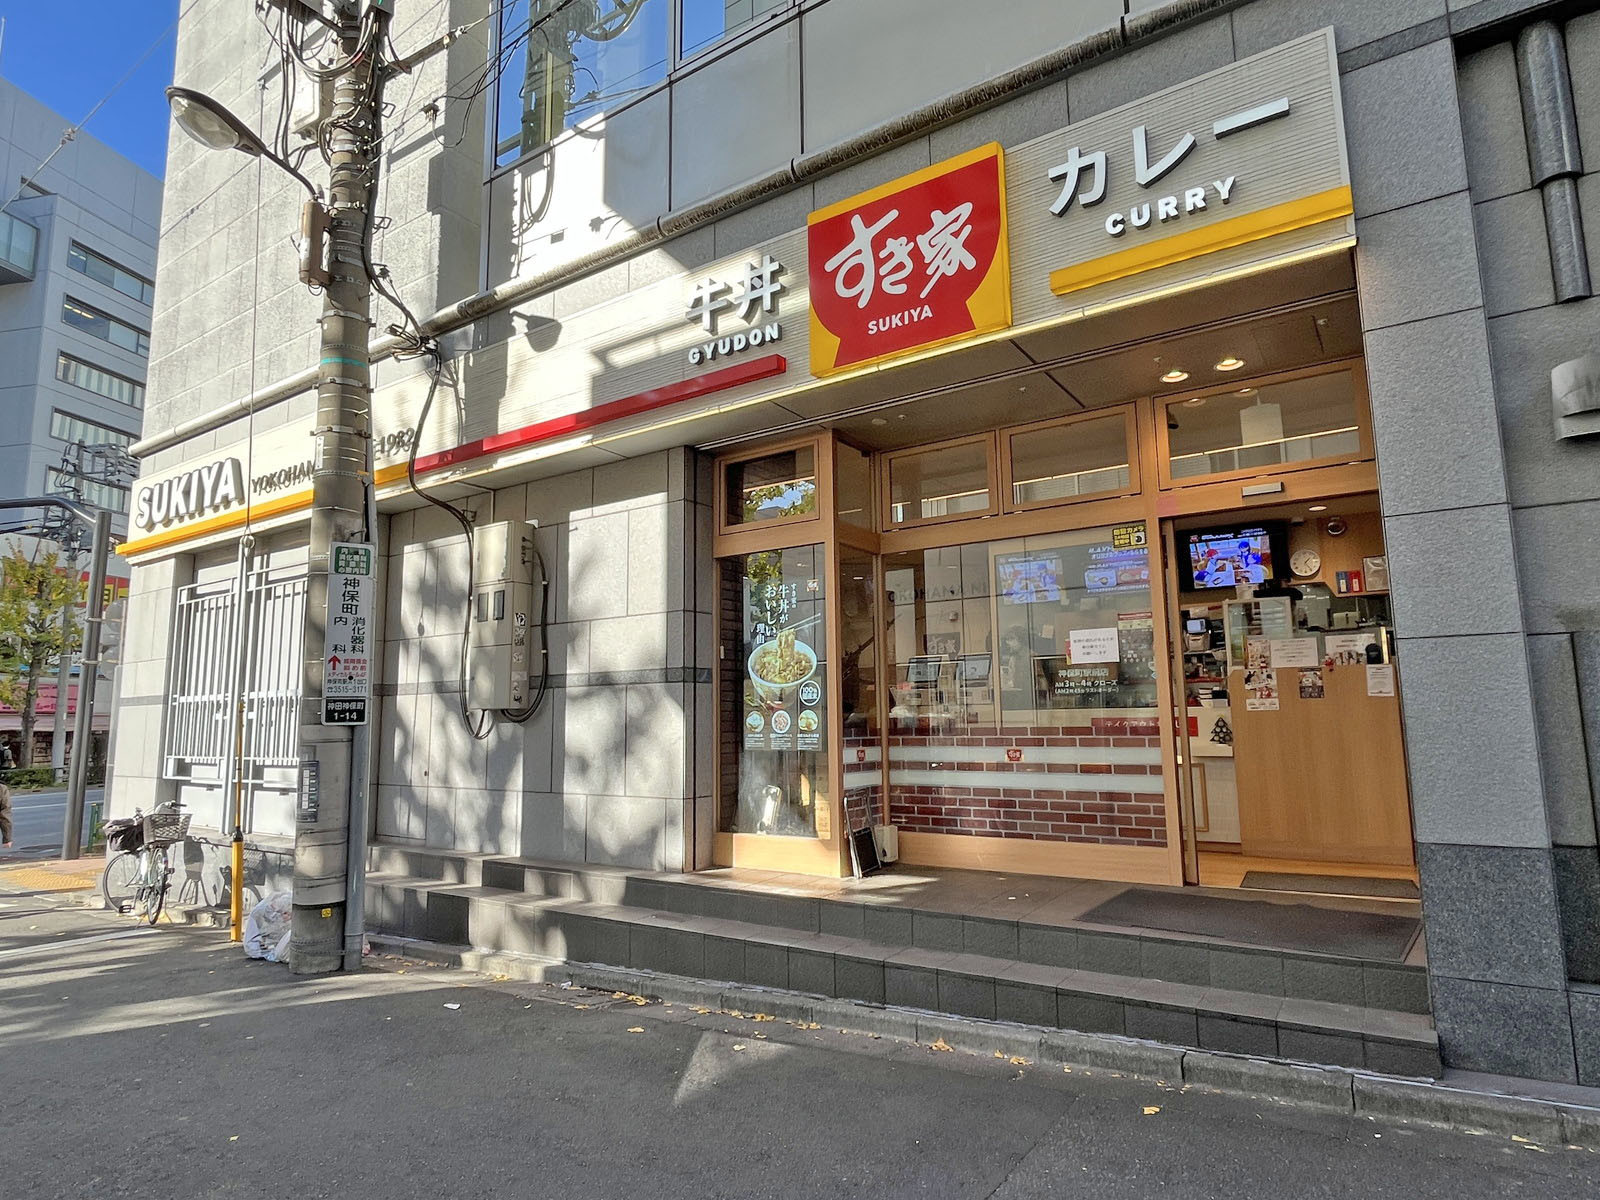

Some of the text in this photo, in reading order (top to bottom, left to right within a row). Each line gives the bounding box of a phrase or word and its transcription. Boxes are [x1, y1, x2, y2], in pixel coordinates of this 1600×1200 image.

[1048, 97, 1290, 217] カレー
[1105, 176, 1236, 237] CURRY
[824, 202, 977, 309] すき家
[686, 255, 783, 332] 牛丼
[868, 305, 933, 335] SUKIYA
[688, 322, 781, 365] GYUDON
[135, 457, 245, 531] SUKIYA
[342, 577, 360, 615] 神保町
[765, 585, 777, 637] おいしい
[778, 584, 790, 623] 牛丼が
[351, 616, 366, 654] 消化器科
[327, 702, 364, 711] 神田神保町
[334, 712, 357, 720] 1-14
